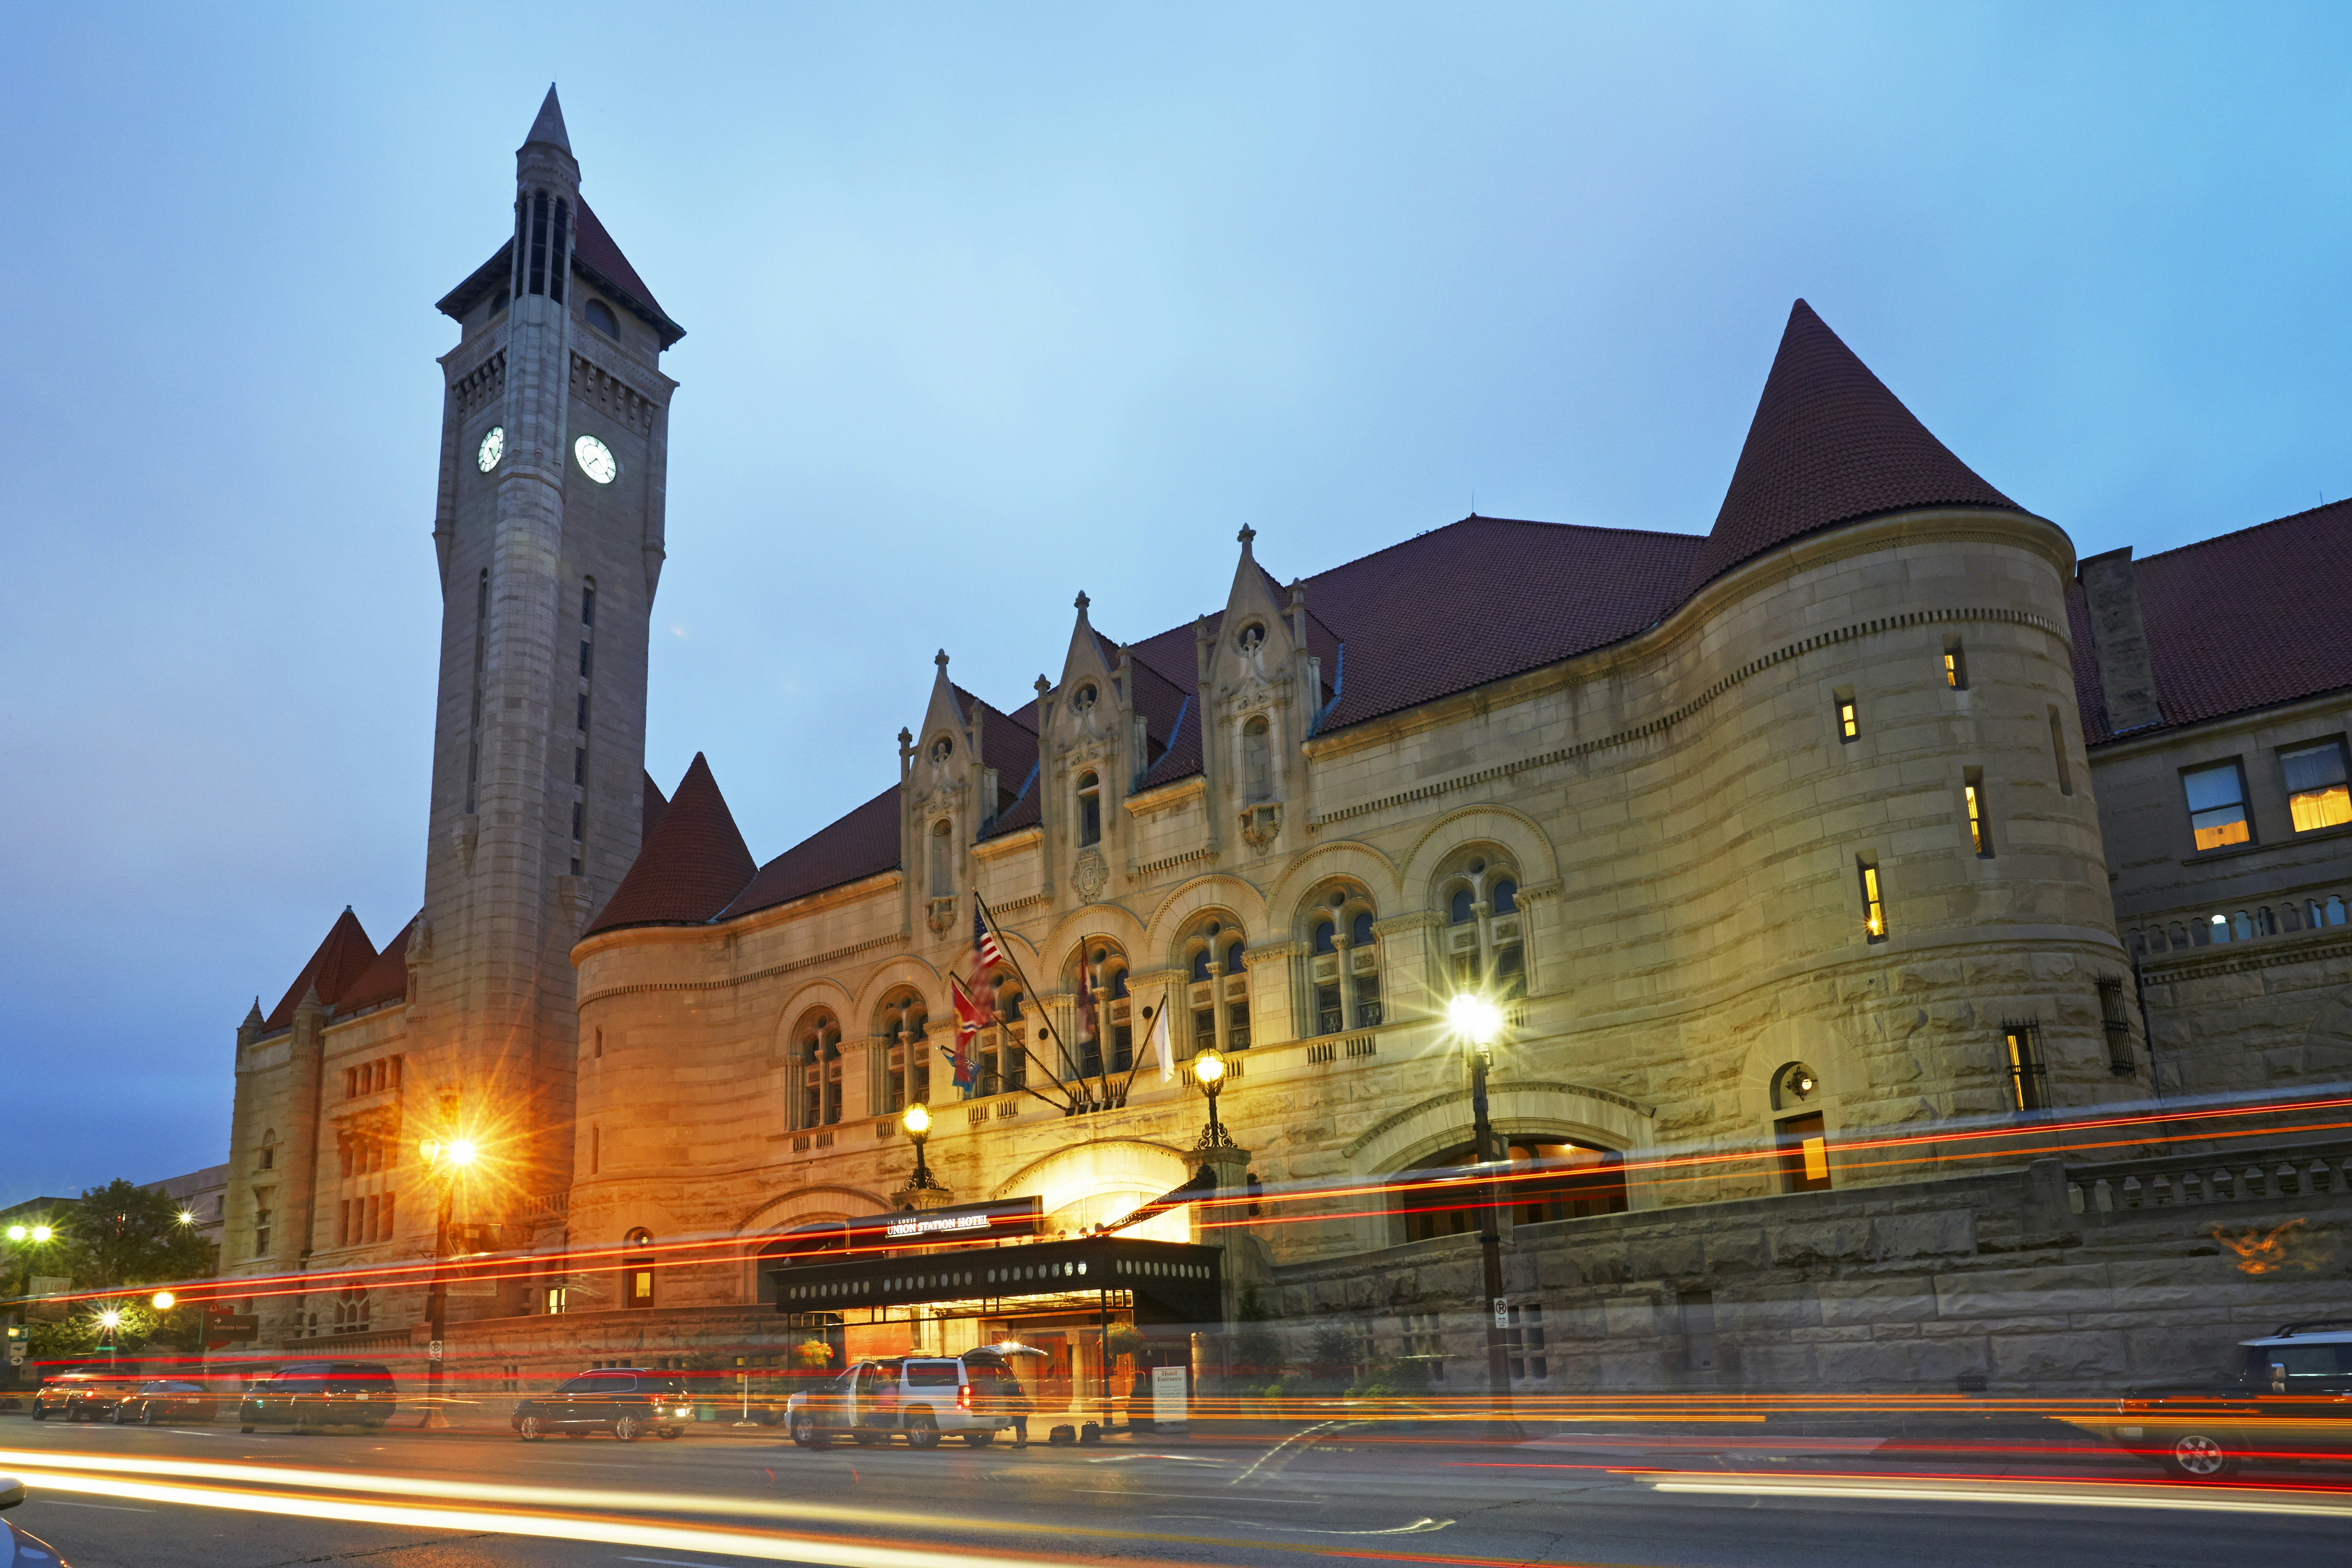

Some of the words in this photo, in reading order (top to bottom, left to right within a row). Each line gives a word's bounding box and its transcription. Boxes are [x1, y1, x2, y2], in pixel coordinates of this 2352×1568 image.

[887, 1223, 916, 1235] UNION
[918, 1218, 956, 1232] STATION
[957, 1215, 989, 1228] HOTEL
